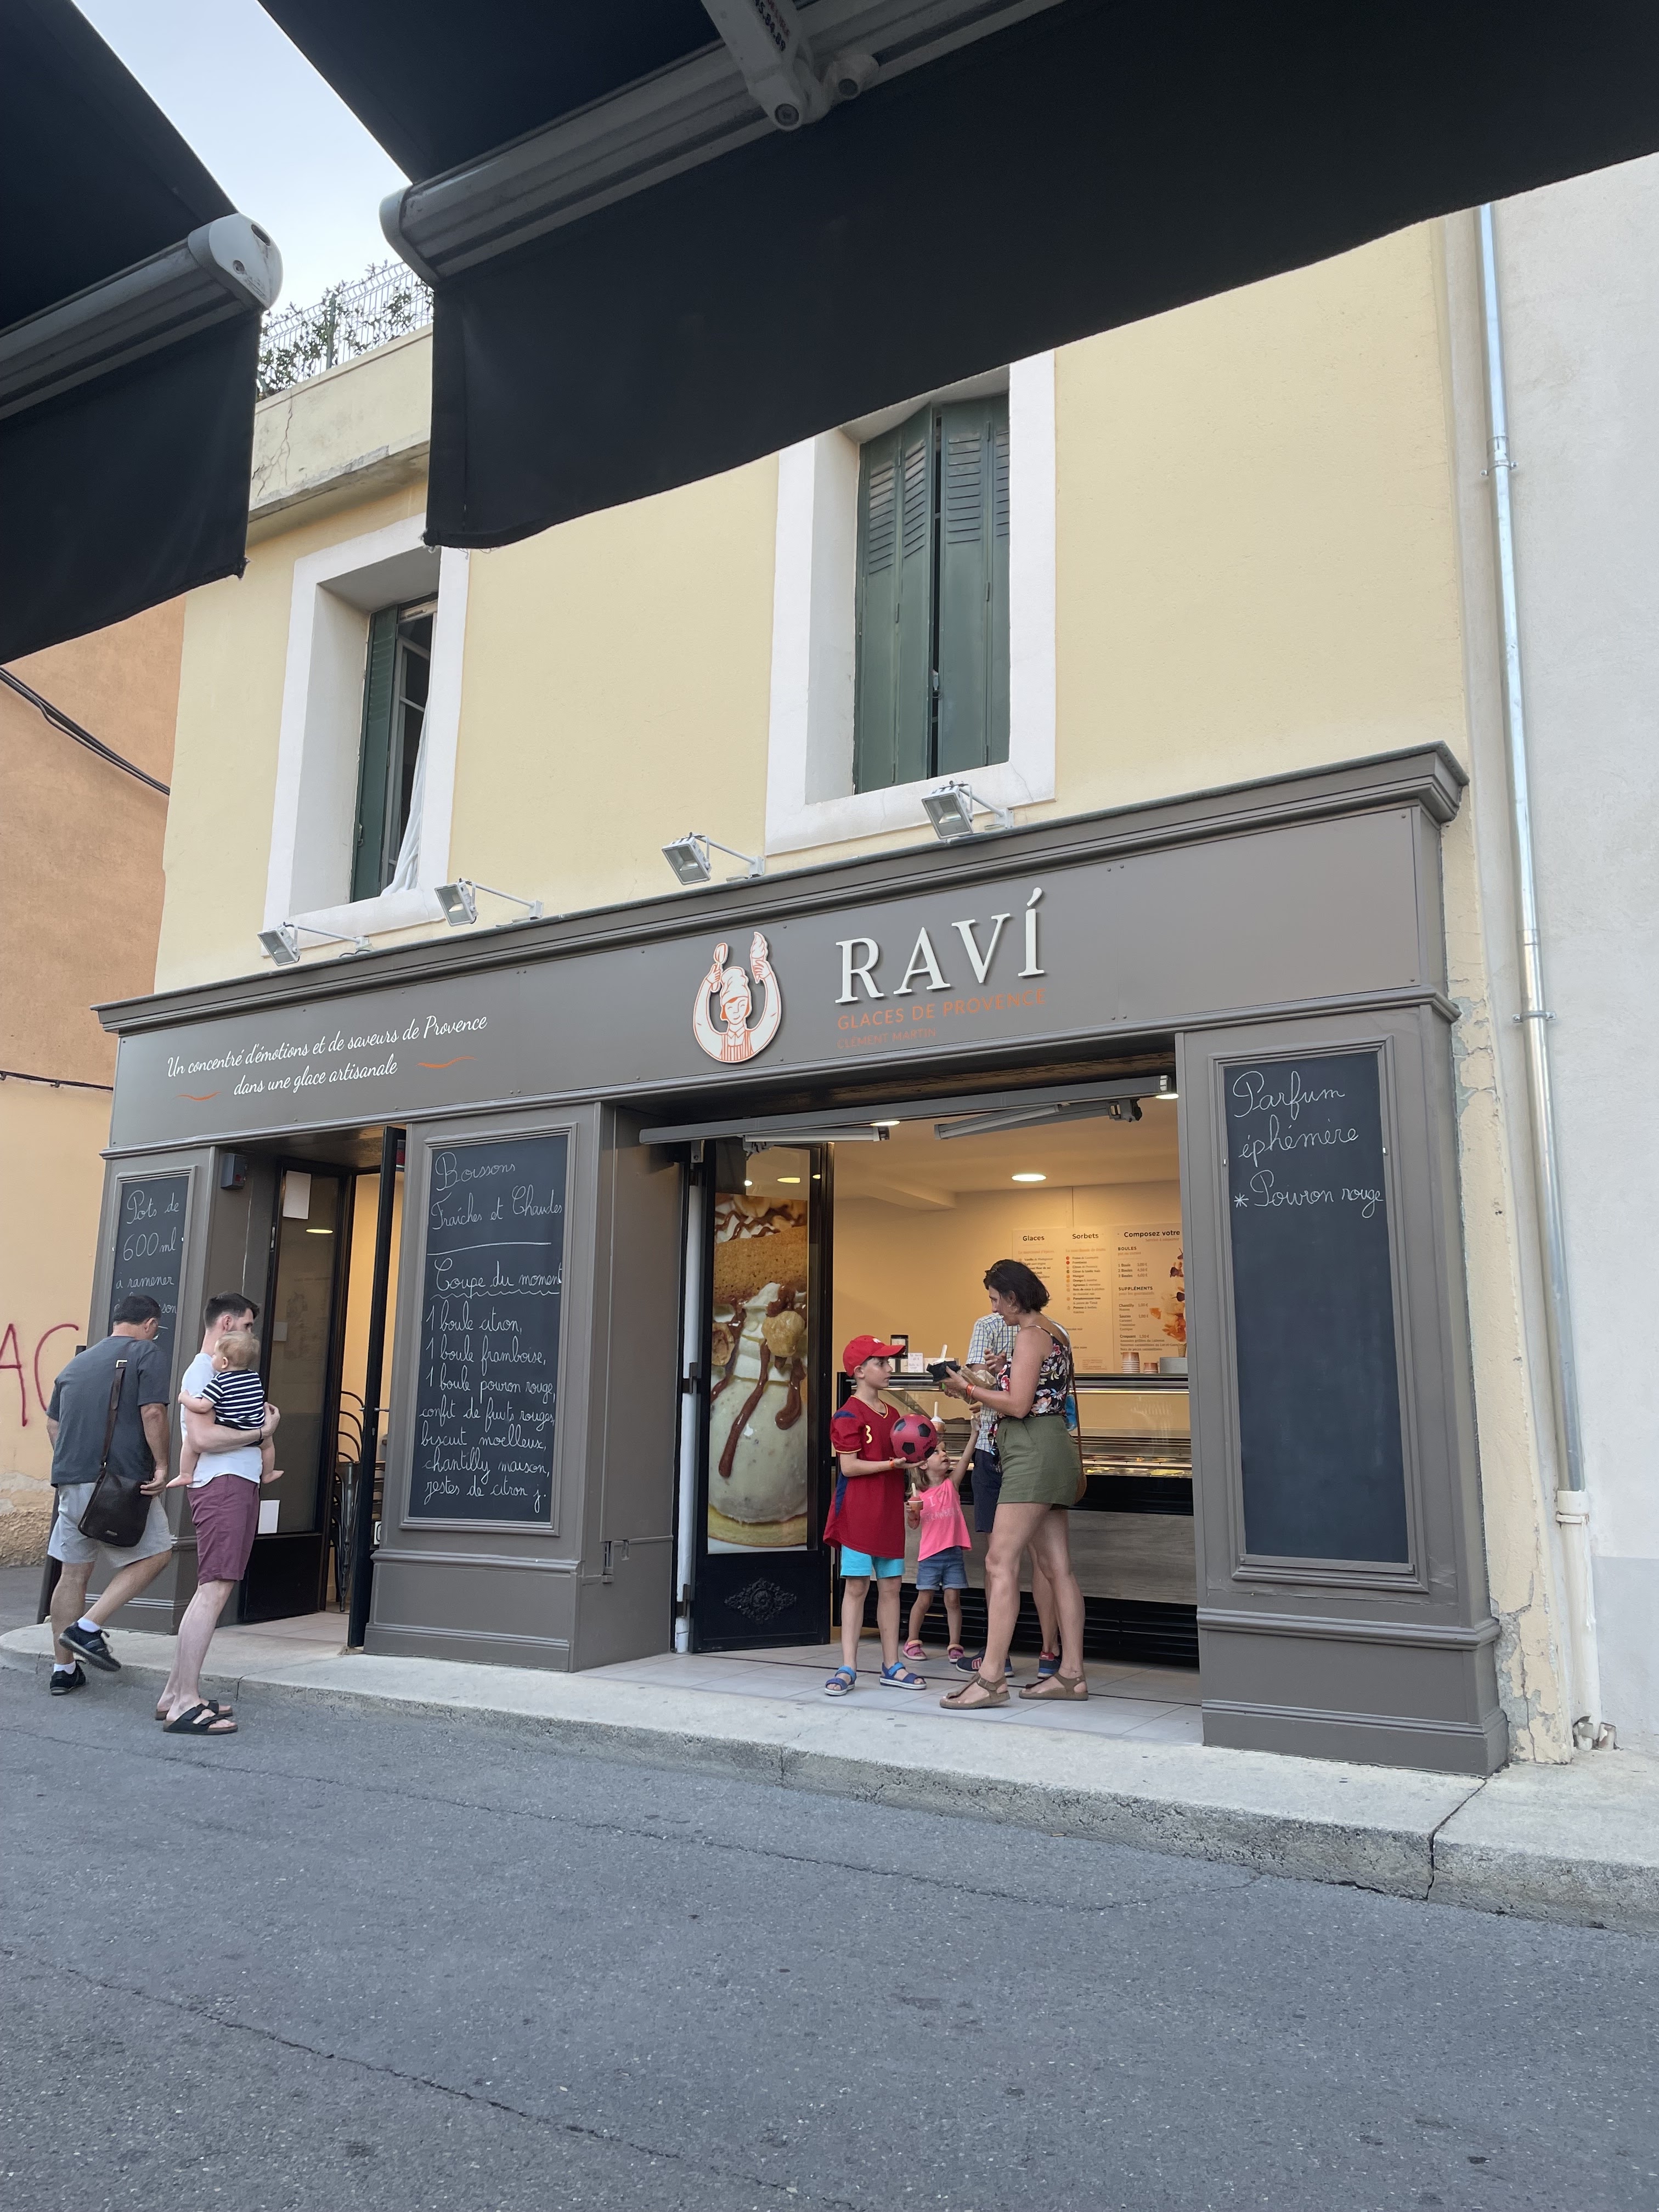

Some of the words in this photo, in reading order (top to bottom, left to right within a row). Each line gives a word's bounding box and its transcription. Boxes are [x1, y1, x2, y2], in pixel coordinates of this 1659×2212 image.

[837, 1008, 904, 1030] GLACES
[912, 1004, 935, 1021] DE
[943, 988, 1046, 1016] PROVENCE
[167, 1056, 185, 1077] Un
[188, 1048, 245, 1074] concentré
[245, 1042, 309, 1064] d'émotions
[313, 1036, 326, 1054] et
[329, 1030, 345, 1052] de
[348, 1030, 399, 1049] saveurs
[402, 1018, 420, 1041] de
[424, 1015, 488, 1039] Provence
[892, 1027, 936, 1043] MARTIN
[234, 1074, 265, 1096] dans
[268, 1077, 291, 1091] une
[293, 1065, 326, 1093] glace
[329, 1053, 398, 1082] artisanale
[1233, 1070, 1346, 1120] Parfum
[1238, 1114, 1359, 1168] éphémère
[435, 1152, 516, 1191] Boissons
[126, 1189, 157, 1224] Pots
[164, 1192, 179, 1214] de
[490, 1197, 504, 1221] et
[511, 1184, 563, 1216] Chaudes
[1341, 1188, 1384, 1218] rouge
[127, 1276, 175, 1289] ramener
[434, 1257, 486, 1299] Coupe
[490, 1261, 515, 1288] du
[518, 1262, 563, 1285] moment
[426, 1305, 435, 1331] 1
[439, 1299, 474, 1331] boule
[426, 1336, 434, 1359] 1
[440, 1333, 475, 1362] boule
[481, 1335, 546, 1376] framboise,
[425, 1365, 434, 1387] 1
[439, 1362, 471, 1391] boule
[525, 1381, 556, 1404] rouge,
[419, 1394, 456, 1426] confit
[463, 1397, 481, 1419] de
[485, 1397, 515, 1432] fruits
[519, 1410, 555, 1432] rouges,
[421, 1420, 467, 1447] biscuit
[478, 1423, 547, 1452] moelleux,
[422, 1446, 491, 1485] chantilly
[498, 1460, 550, 1477] maison,
[424, 1475, 460, 1505] zestes
[466, 1475, 484, 1497] de
[490, 1475, 528, 1497] citron
